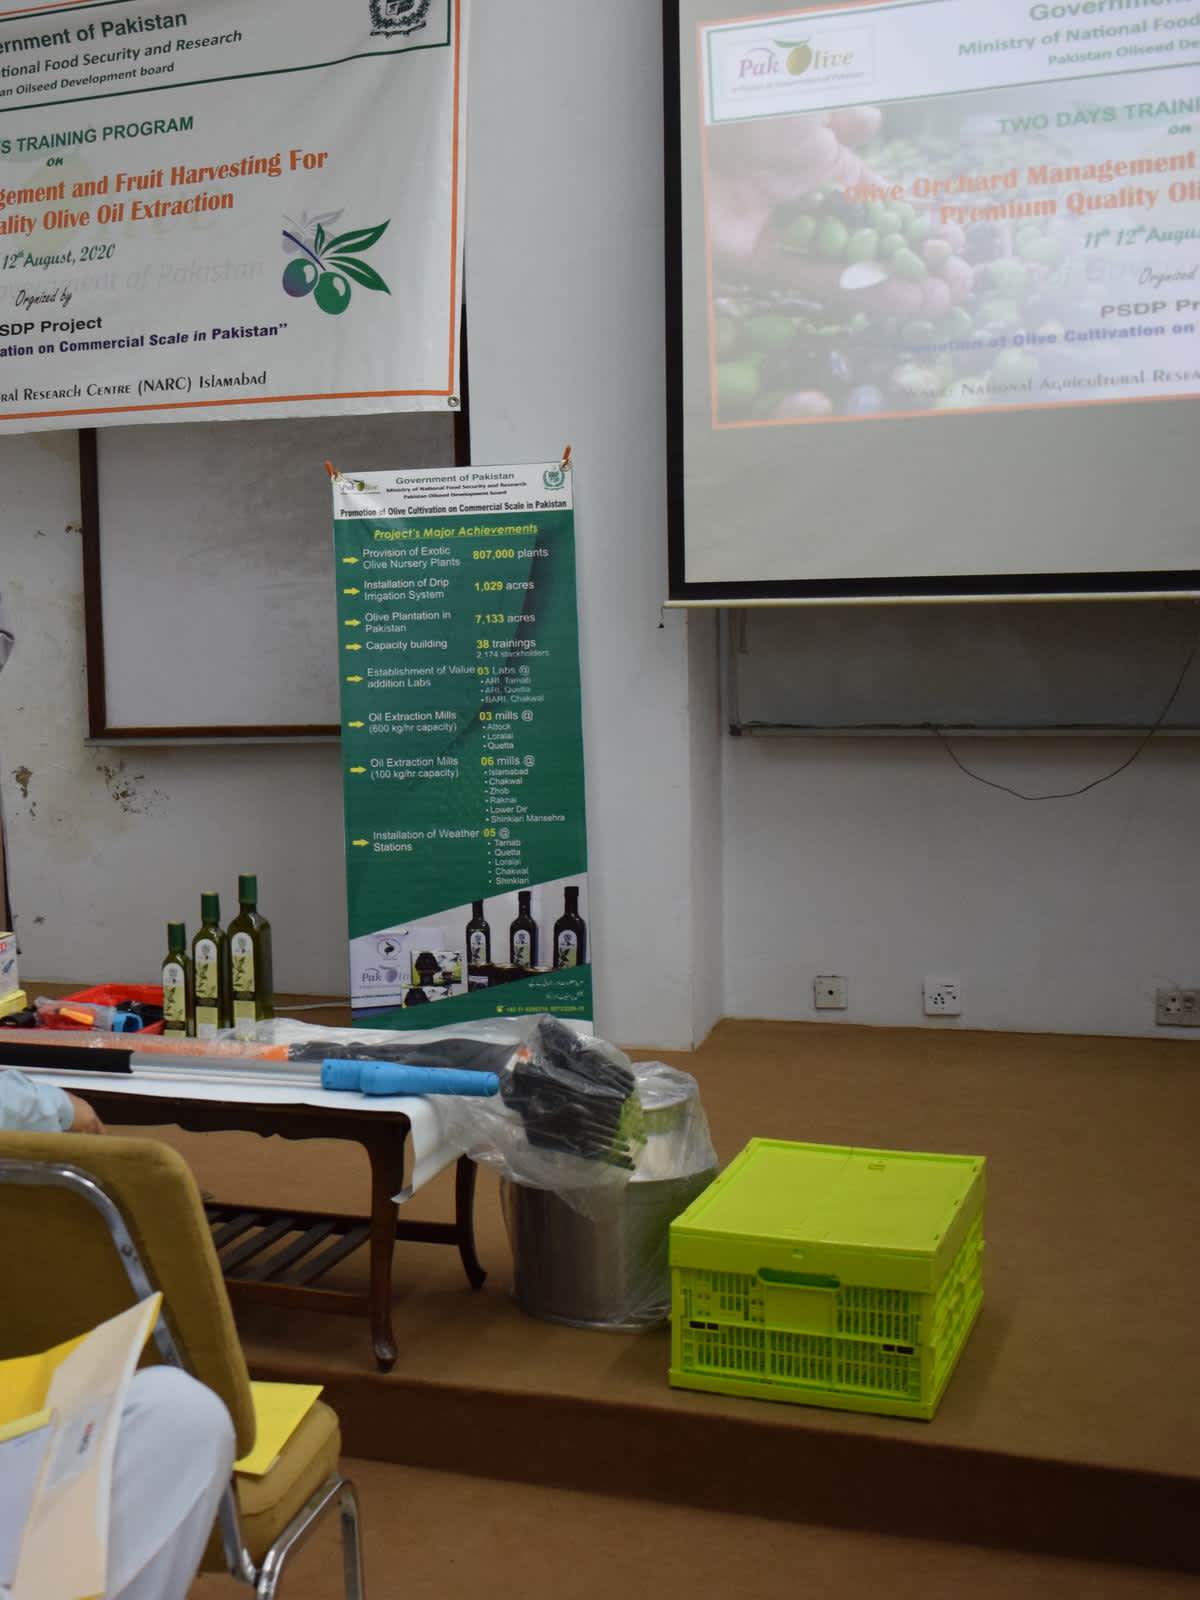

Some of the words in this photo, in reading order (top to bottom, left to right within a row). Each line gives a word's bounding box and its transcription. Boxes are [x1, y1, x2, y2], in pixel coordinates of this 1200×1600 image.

[76, 25, 95, 41] of
[101, 12, 187, 38] Pakistan
[959, 35, 1037, 57] Ministry
[1041, 29, 1060, 46] of
[1066, 20, 1147, 42] National
[45, 55, 79, 71] Food
[83, 41, 140, 66] Security
[144, 41, 171, 57] and
[175, 29, 242, 53] Research
[1048, 48, 1112, 65] Pakistan
[1116, 40, 1174, 58] Oilseed
[16, 78, 57, 96] Oilseed
[61, 67, 138, 91] Development
[140, 61, 175, 78] board
[999, 112, 1047, 135] TWO
[1056, 106, 1117, 130] DAYS
[16, 128, 97, 153] TRAINING
[102, 116, 194, 142] PROGRAM
[72, 175, 108, 198] and
[115, 169, 163, 193] Fruit
[170, 153, 281, 187] Harvesting
[290, 149, 328, 171] For
[912, 167, 1017, 200] Orchard
[1027, 149, 1196, 185] Management
[43, 209, 90, 231] Olive
[97, 203, 124, 225] Oil
[131, 192, 234, 222] Extraction
[939, 199, 1057, 225] Premium
[1066, 185, 1159, 215] Quality
[80, 244, 116, 265] 2020
[60, 286, 72, 308] by
[1101, 301, 1167, 319] PSDP
[41, 316, 103, 336] Project
[1064, 324, 1166, 343] Cultivation
[1172, 322, 1195, 335] on
[38, 344, 55, 356] on
[59, 335, 144, 354] Commercial
[149, 331, 188, 347] Scale
[193, 329, 207, 343] in
[137, 376, 192, 396] (NARC)
[395, 474, 457, 486] Government
[472, 471, 515, 482] Pakistan
[340, 508, 377, 518] Promotion
[388, 506, 406, 516] Olive
[408, 504, 446, 515] Cultivation
[459, 502, 502, 513] Commercial
[504, 501, 524, 511] Scale
[535, 499, 567, 509] Pakistan
[373, 527, 421, 541] Project's
[423, 526, 455, 539] Major
[458, 523, 538, 536] Achievements
[363, 547, 406, 557] Provision
[421, 546, 451, 556] Exotic
[517, 547, 549, 559] plants
[363, 559, 387, 570] Olive
[390, 558, 428, 571] Nursery
[430, 557, 460, 567] Plants
[364, 578, 414, 589] Installation
[429, 577, 449, 589] Drip
[505, 581, 535, 591] acres
[364, 590, 406, 602] Irrigation
[408, 589, 445, 601] System
[365, 612, 389, 622] Olive
[392, 610, 440, 621] Plantation
[506, 613, 536, 623] acres
[365, 623, 406, 633] Pakistan
[366, 640, 408, 651] Capacity
[410, 639, 448, 651] building
[476, 639, 489, 649] 38
[492, 638, 536, 650] trainings
[367, 666, 437, 677] Establishment
[367, 678, 405, 688] addition
[408, 677, 431, 688] Labs
[369, 711, 385, 721] Oil
[387, 711, 432, 721] Extraction
[435, 710, 457, 720] Mills
[495, 710, 518, 721] mills
[417, 722, 457, 733] capacity)
[387, 757, 433, 768] Extraction
[437, 756, 458, 766] Mills
[481, 757, 494, 766] 06
[496, 755, 520, 766] mills
[418, 768, 459, 779] capacity)
[373, 830, 424, 841] Installation
[438, 829, 480, 839] Weather
[373, 842, 413, 852] Stations
